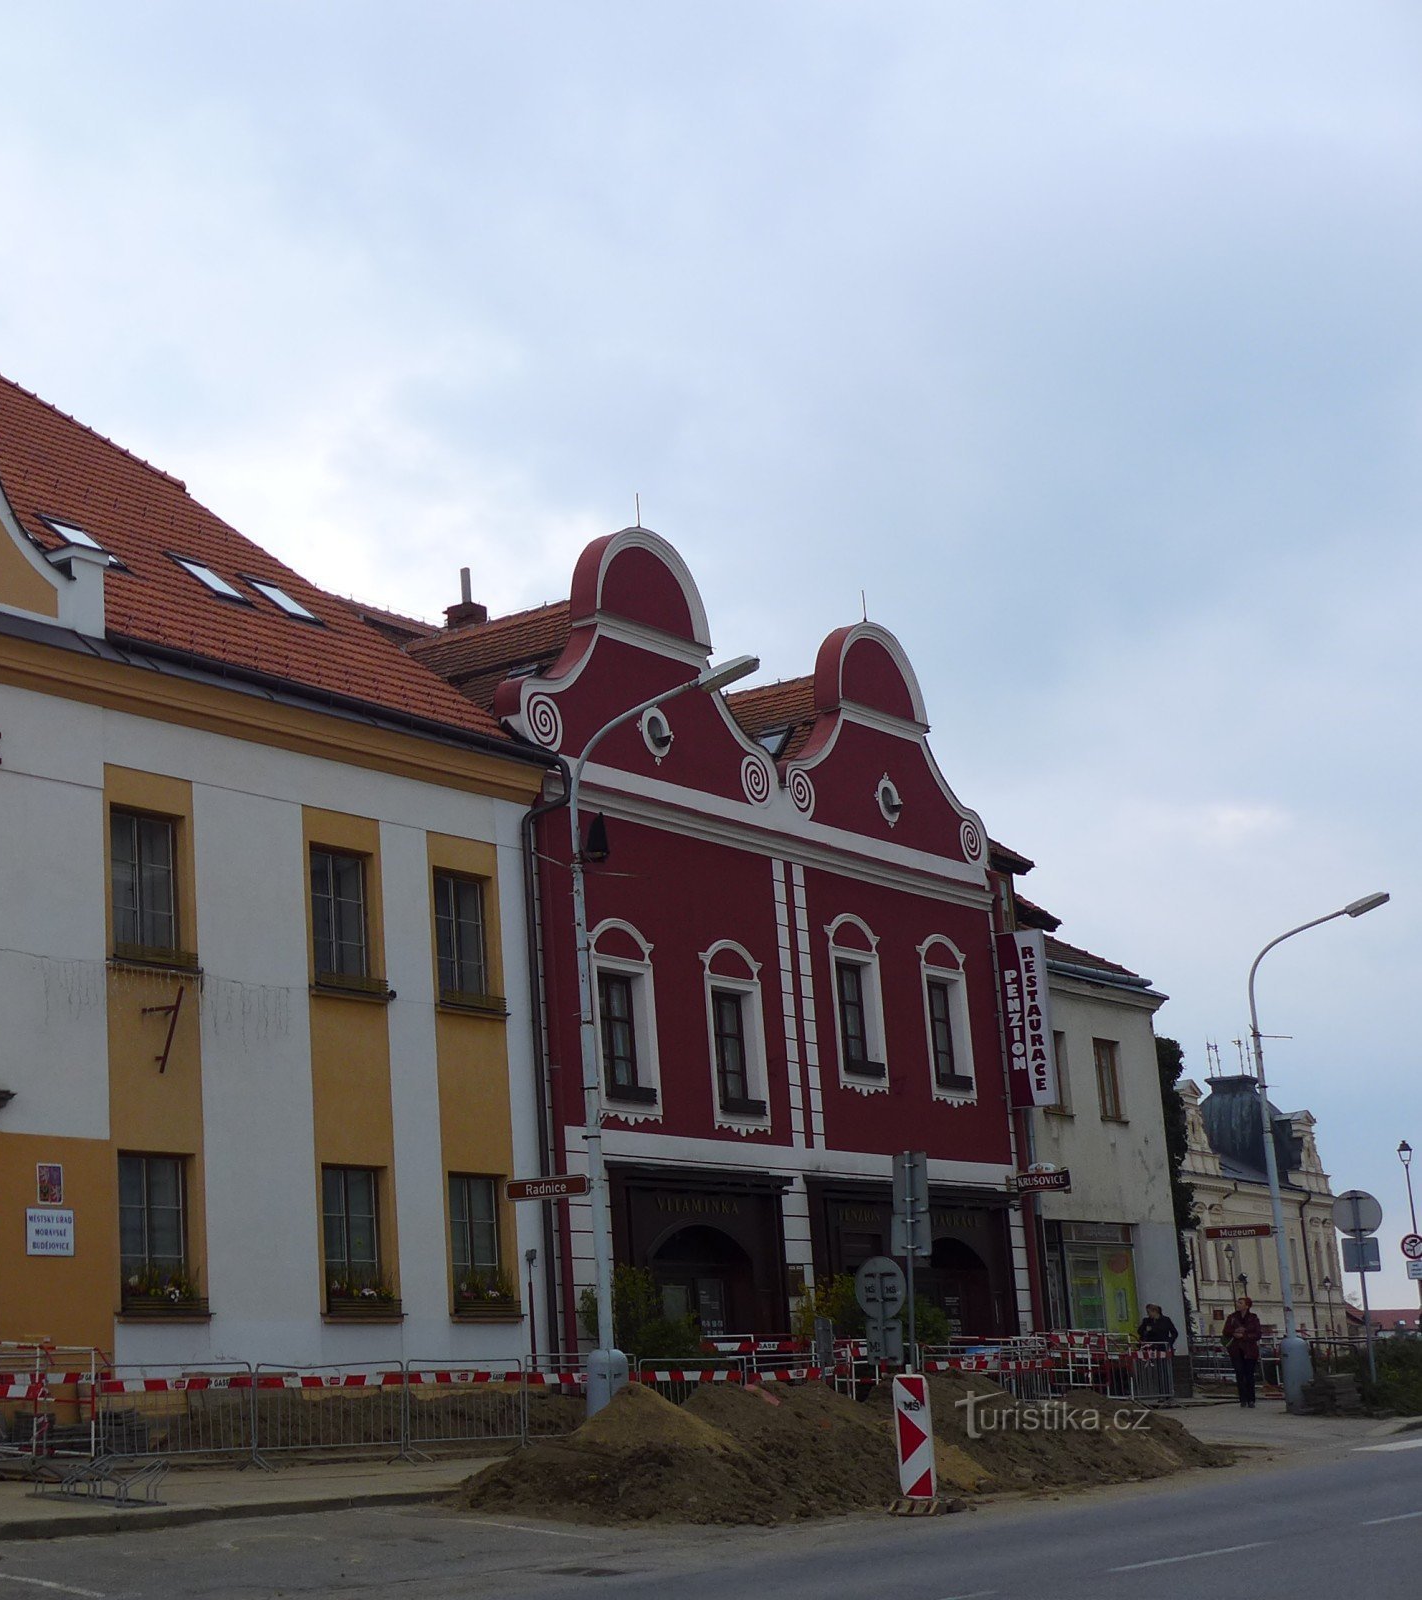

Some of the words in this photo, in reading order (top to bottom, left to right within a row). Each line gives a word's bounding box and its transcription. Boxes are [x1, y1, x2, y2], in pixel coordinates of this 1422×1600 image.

[1004, 970, 1026, 1071] PENZION
[1021, 946, 1047, 1091] RESTAURACE
[1017, 1174, 1065, 1188] KRUŠOVICE
[525, 1182, 567, 1196] Radnice
[1219, 1228, 1256, 1238] Muzeum
[903, 1400, 920, 1411] MŠ
